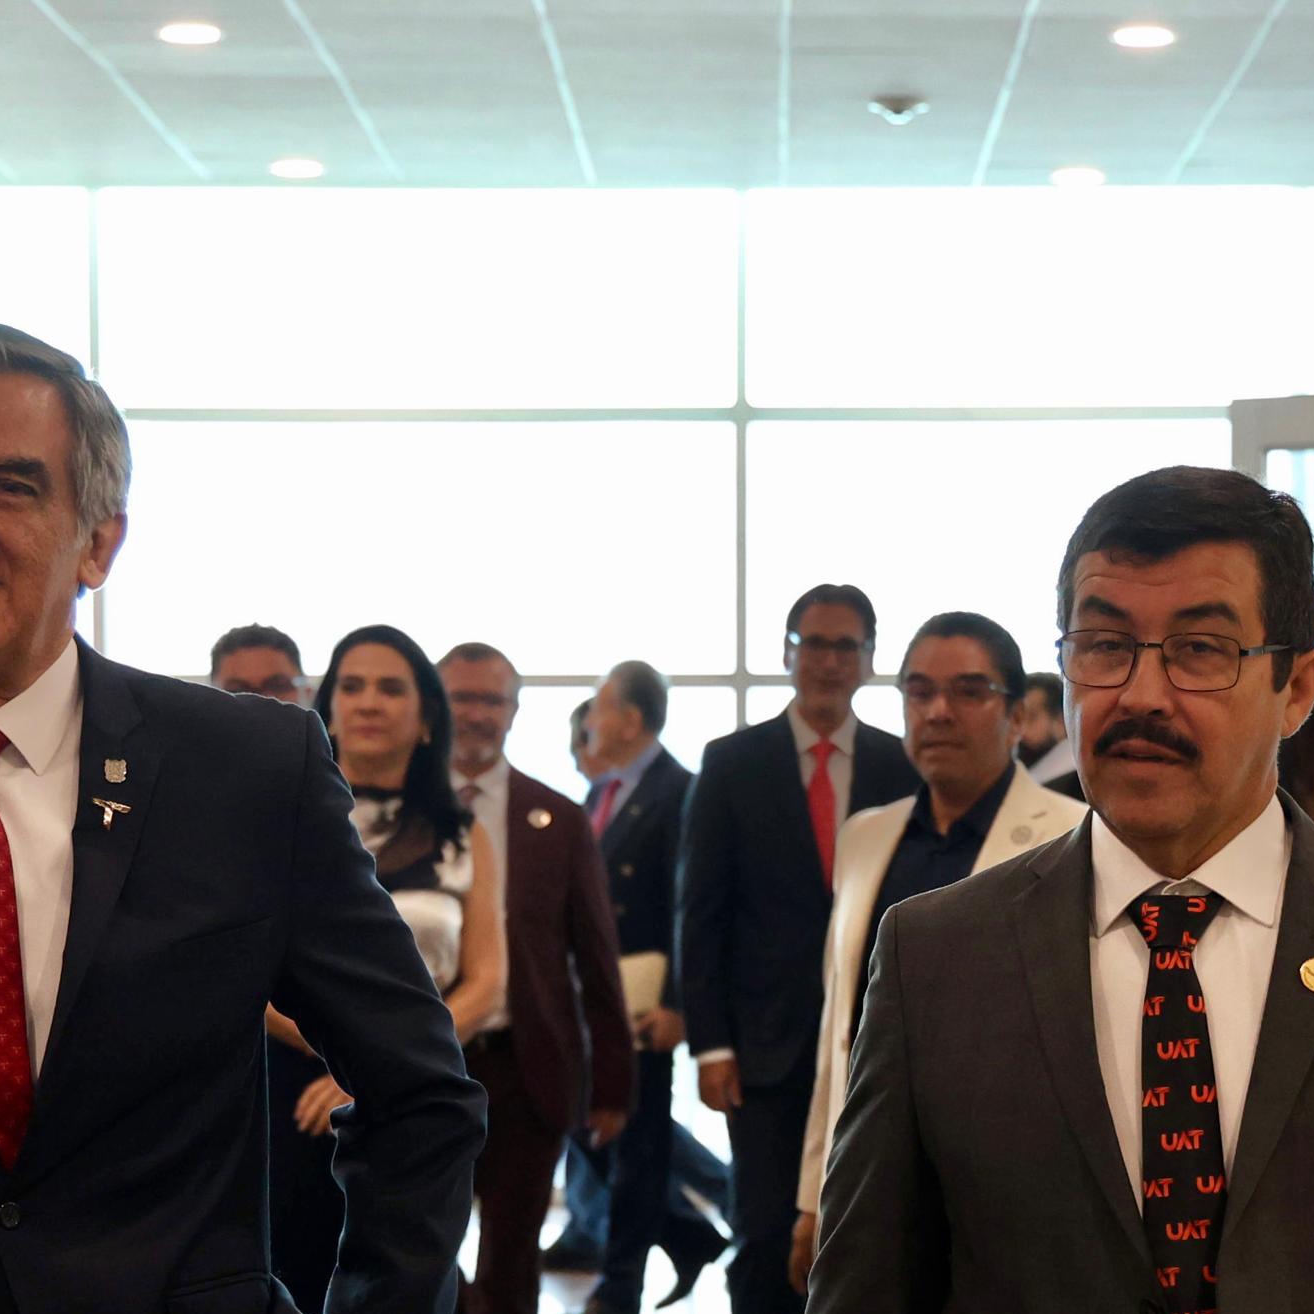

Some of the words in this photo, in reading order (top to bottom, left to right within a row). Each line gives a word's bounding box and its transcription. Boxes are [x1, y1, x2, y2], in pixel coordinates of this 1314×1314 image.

[1155, 949, 1192, 970] UAT
[1156, 1038, 1200, 1060] UAT
[1160, 1129, 1204, 1151] UAT
[1165, 1219, 1211, 1241] UAT
